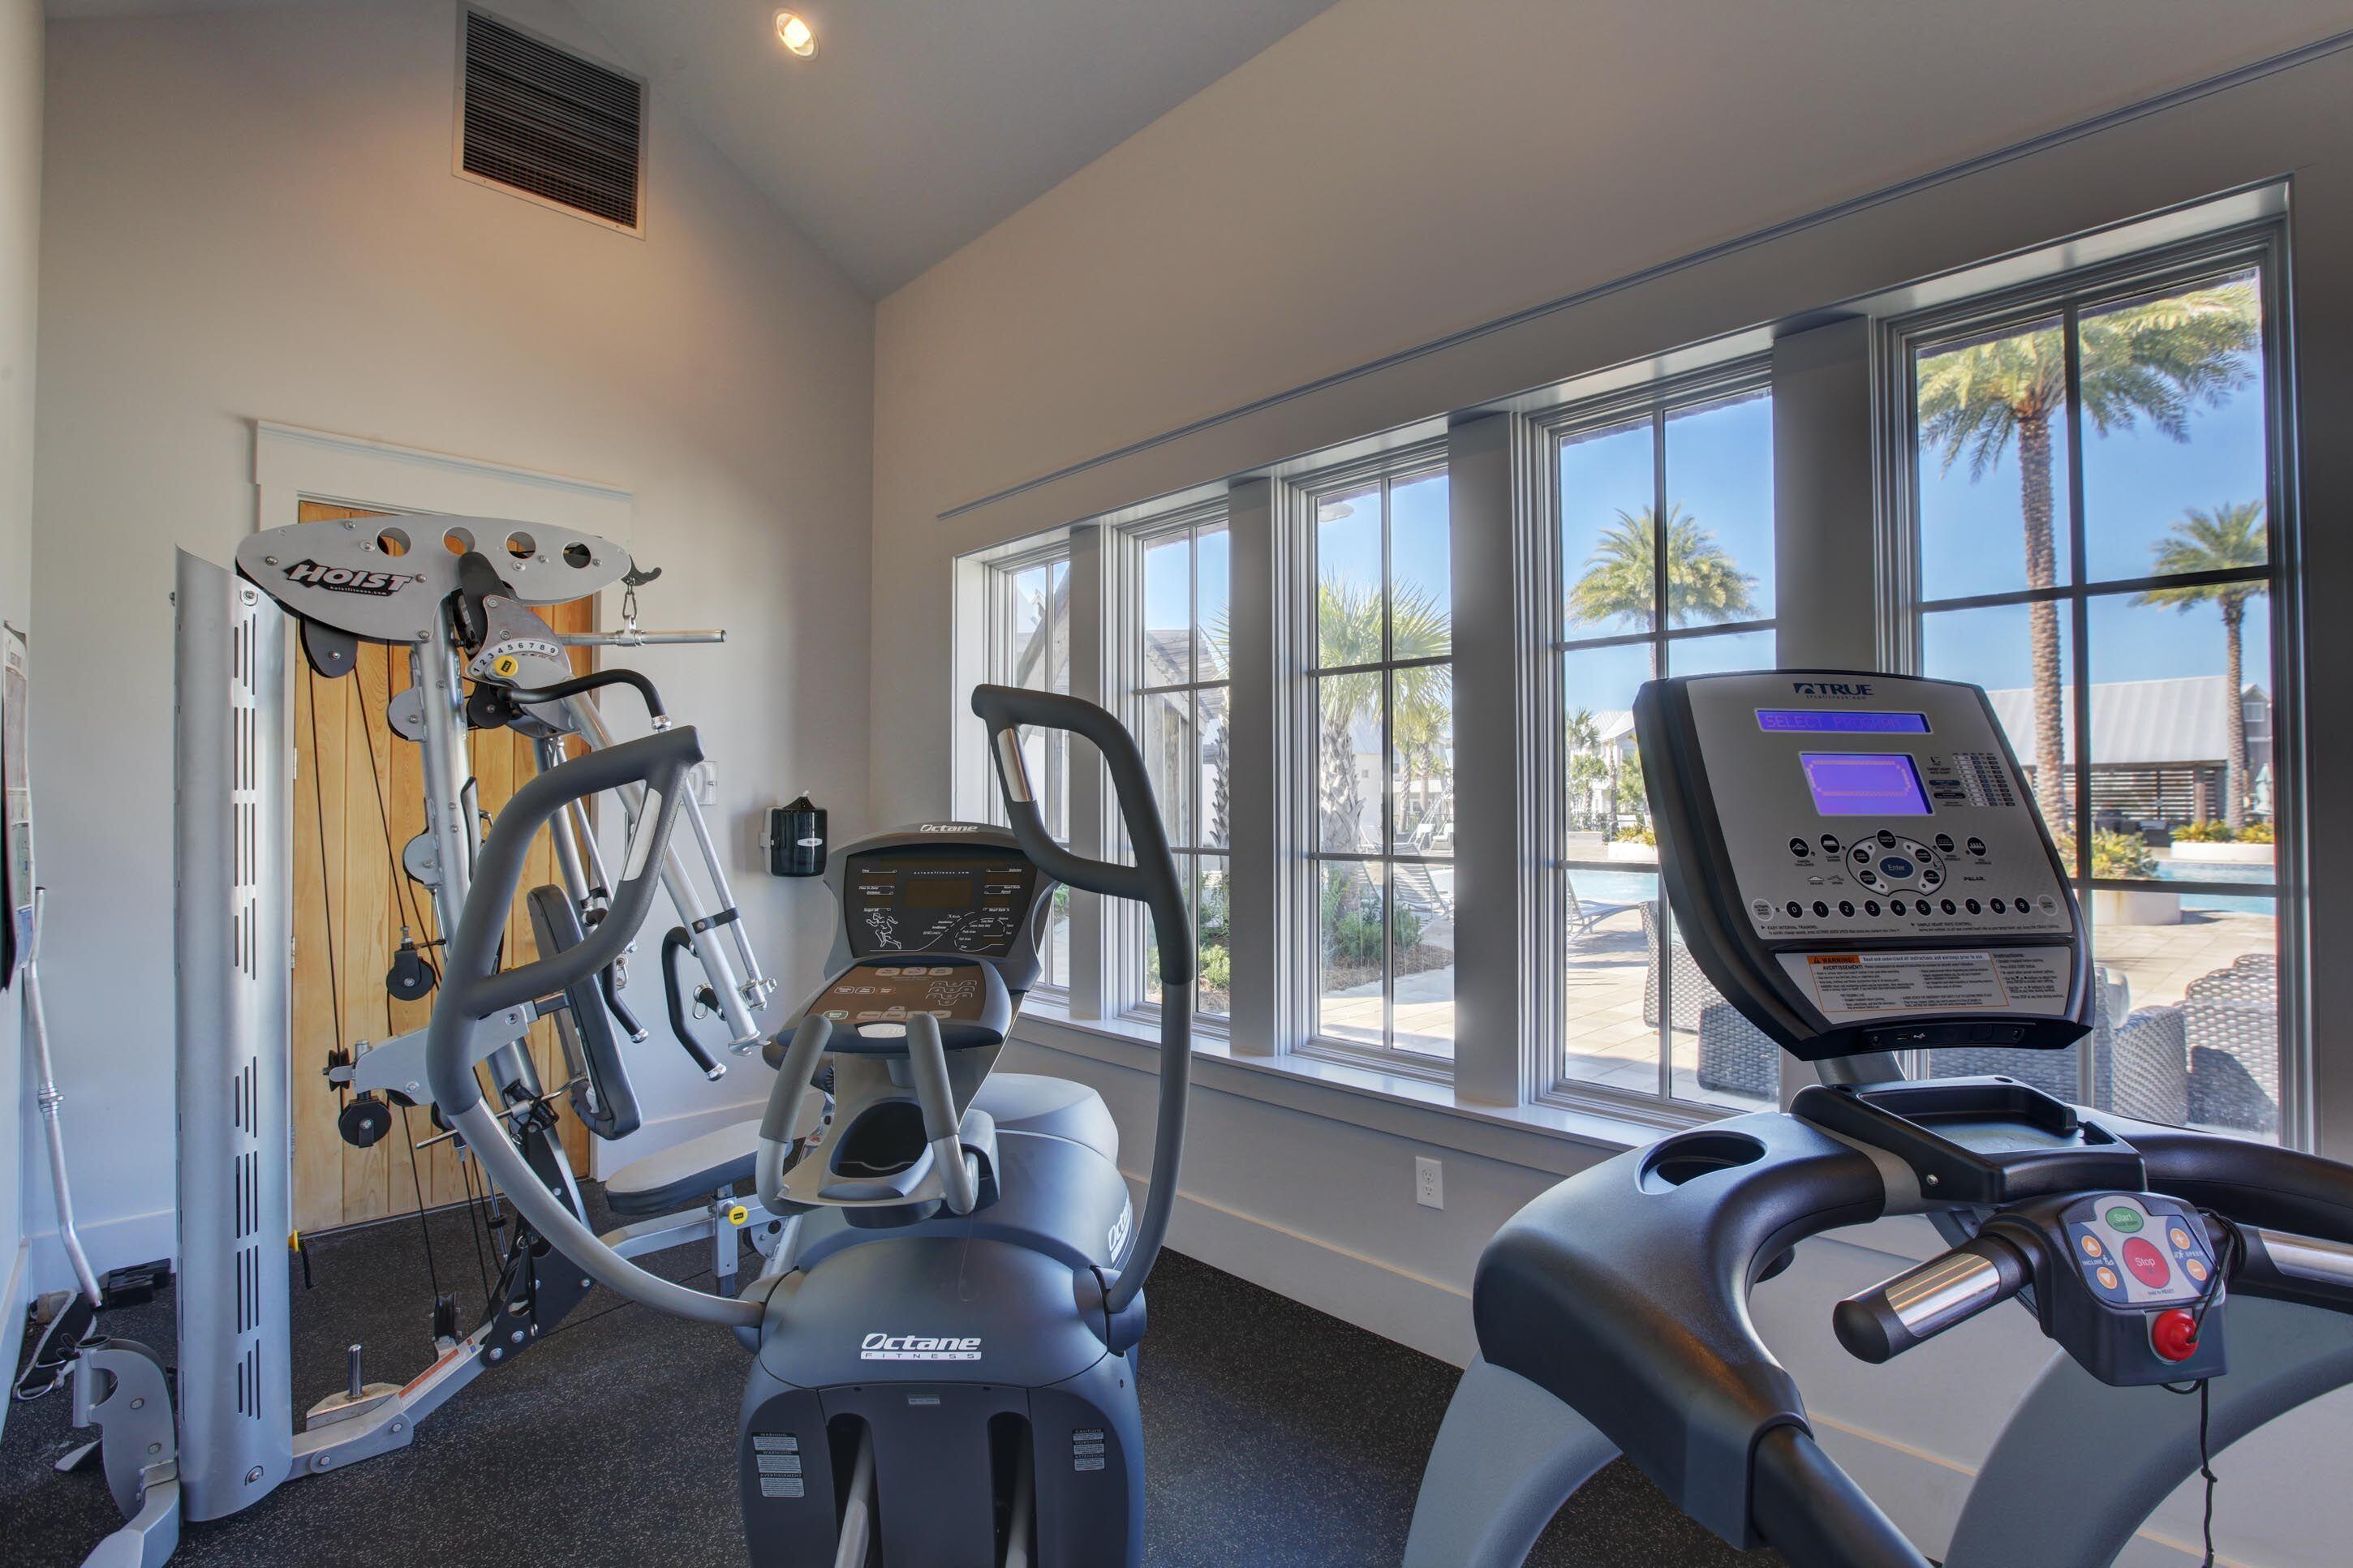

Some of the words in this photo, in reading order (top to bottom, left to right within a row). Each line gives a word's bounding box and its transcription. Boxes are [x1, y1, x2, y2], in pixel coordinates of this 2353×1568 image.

[289, 564, 412, 591] HOIST
[1813, 683, 1874, 695] TRUE
[1766, 715, 1822, 728] SELECT
[2114, 1214, 2133, 1222] Start
[2135, 1257, 2156, 1267] Stop
[862, 1333, 982, 1351] Octane
